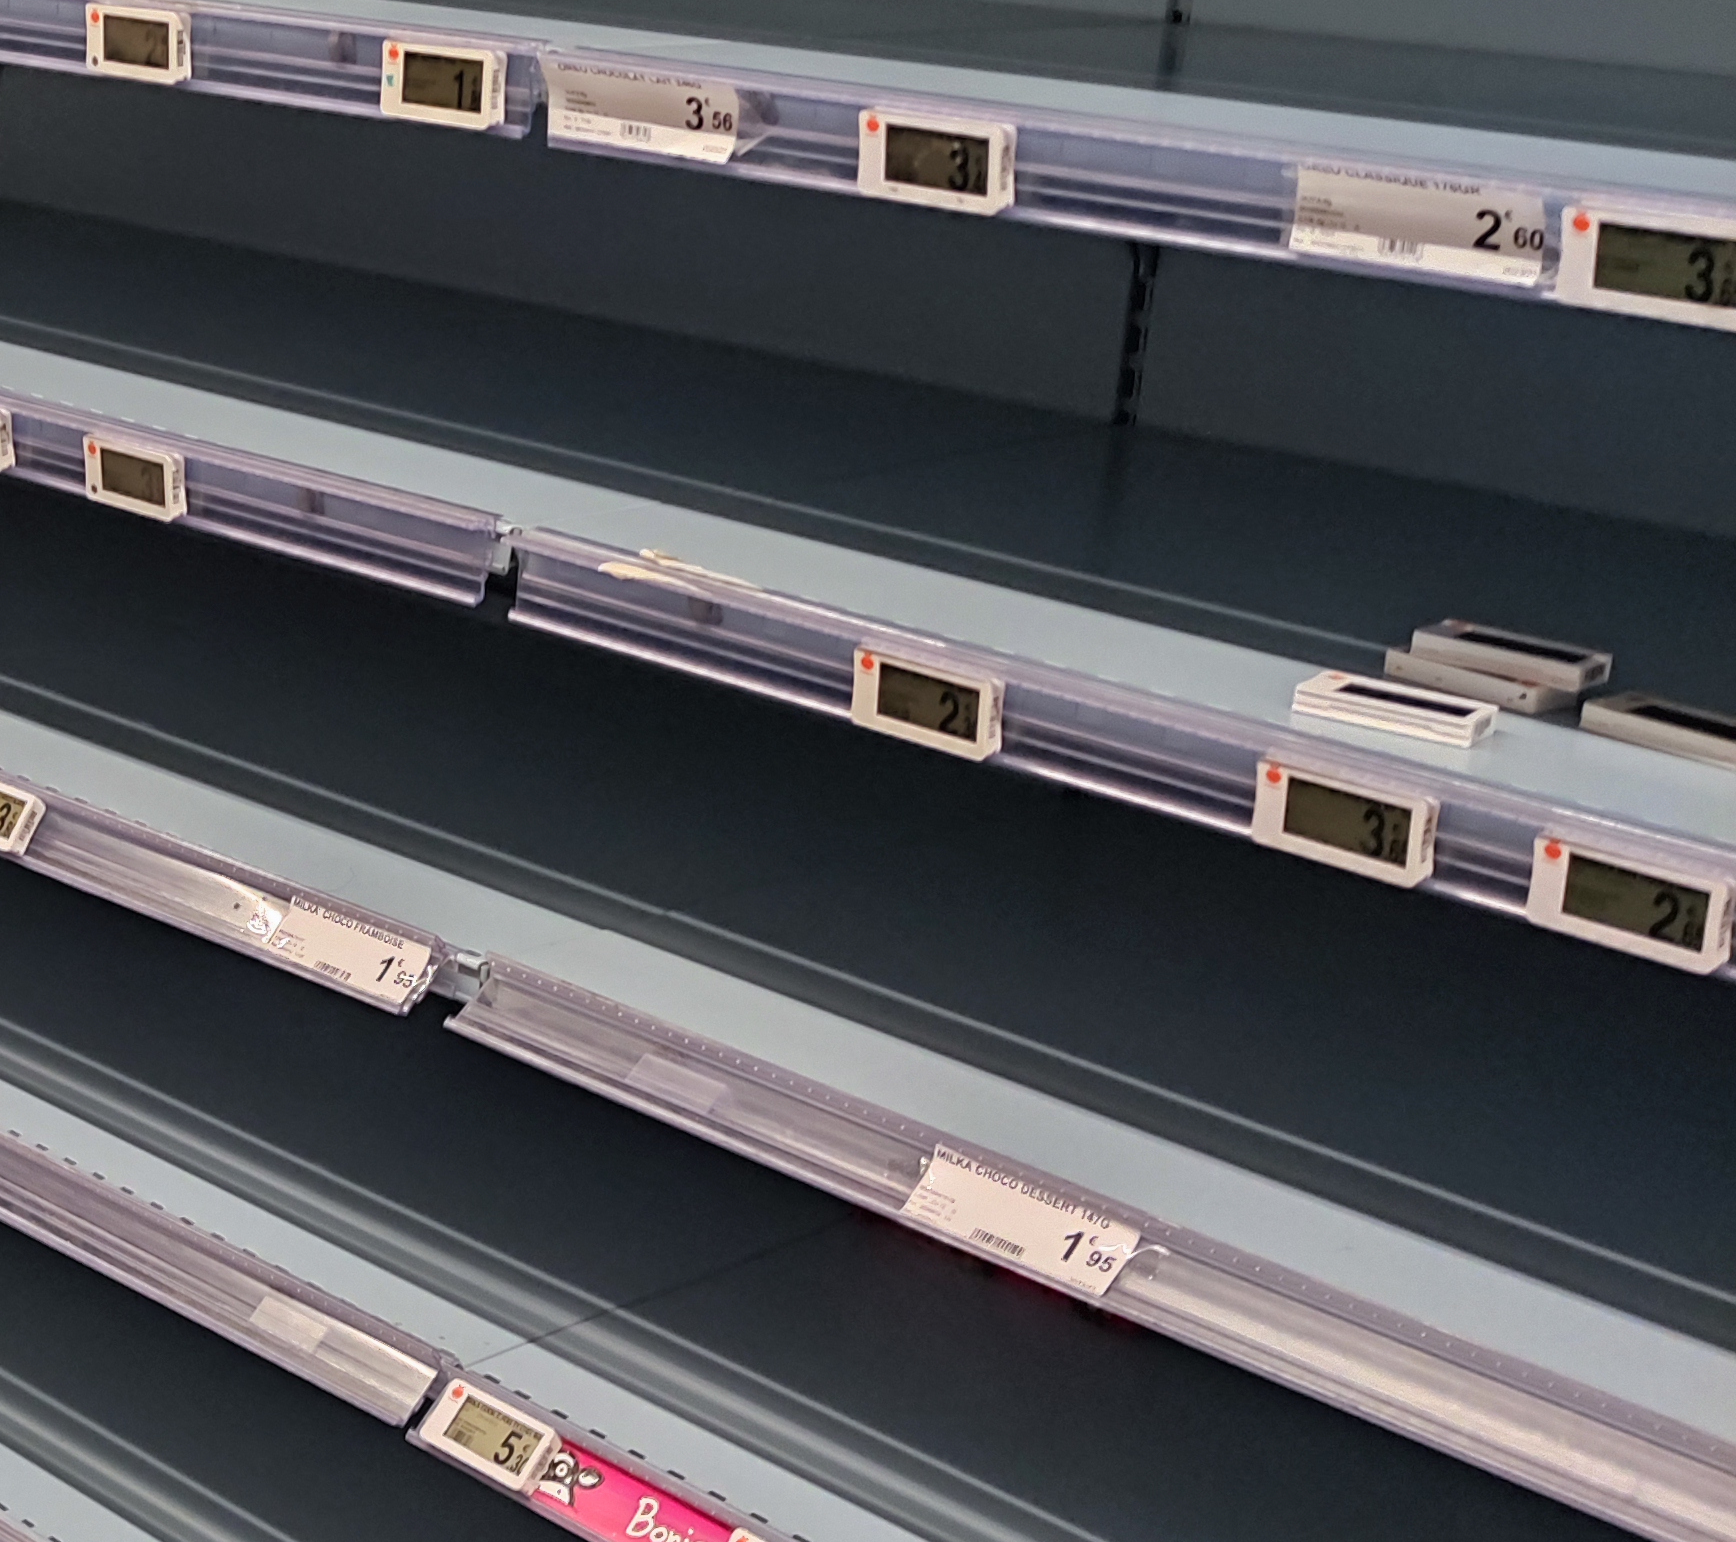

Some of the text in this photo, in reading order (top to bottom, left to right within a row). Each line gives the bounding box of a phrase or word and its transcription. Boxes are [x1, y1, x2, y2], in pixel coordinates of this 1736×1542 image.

[1683, 245, 1715, 302] 3
[938, 690, 961, 736] 2
[1363, 808, 1386, 857] 3
[322, 909, 354, 929] CHOCO
[353, 922, 405, 950] FRAMBOISE
[1648, 888, 1680, 940] 2
[936, 1149, 973, 1172] MILKA
[974, 1164, 1019, 1191] CHOCO
[1020, 1184, 1076, 1216] DESSERT
